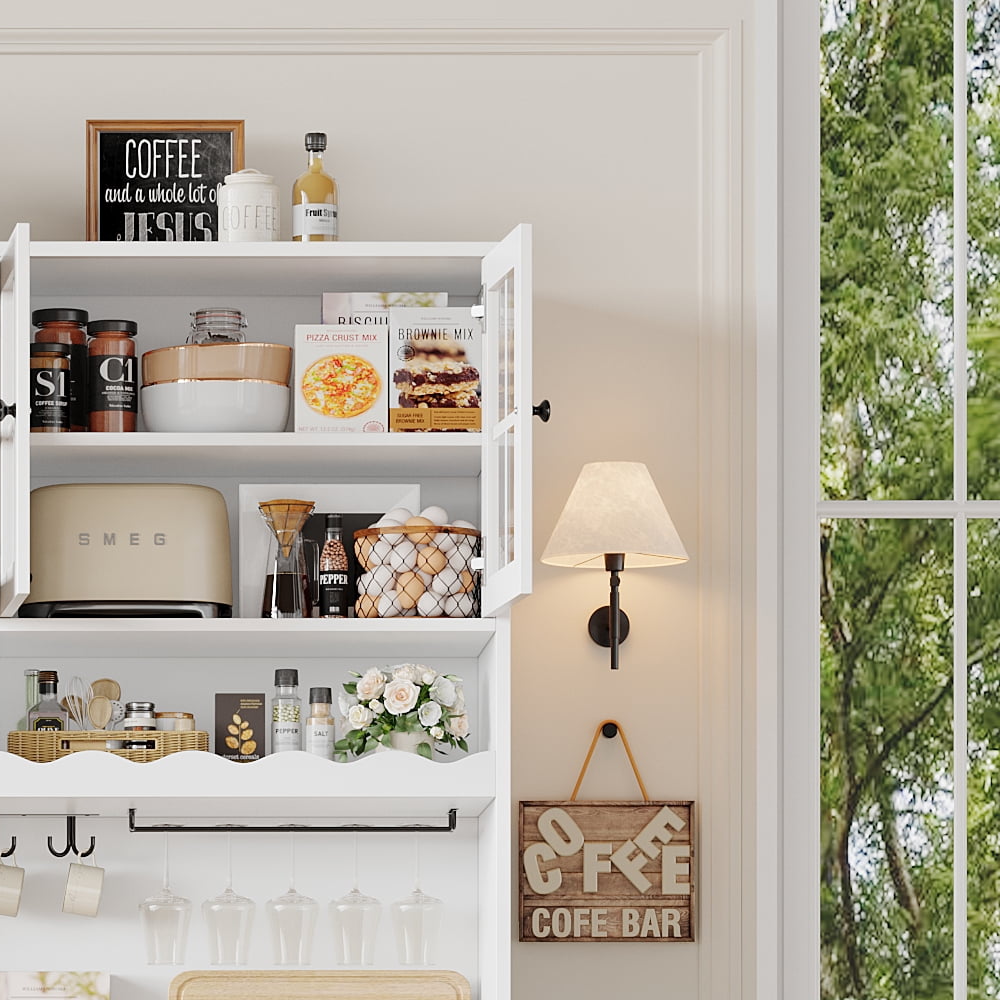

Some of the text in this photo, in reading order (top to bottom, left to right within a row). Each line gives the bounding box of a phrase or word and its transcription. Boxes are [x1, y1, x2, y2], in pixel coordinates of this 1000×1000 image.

[125, 138, 202, 178] COFFEE
[104, 182, 133, 203] and
[135, 187, 146, 203] a
[148, 182, 186, 203] whole
[188, 182, 208, 203] lot
[222, 204, 277, 231] COFFEE
[305, 208, 322, 217] Fruit
[121, 211, 213, 242] JESUS
[306, 333, 377, 341] PIZZA CRUST MIX
[398, 328, 474, 341] BROWNIE MIX
[99, 356, 135, 384] C1
[34, 370, 67, 398] S1
[78, 532, 168, 547] SMEG
[319, 573, 348, 585] PEPPER
[523, 805, 691, 895] COFFEE
[532, 907, 682, 938] COFE BAR
